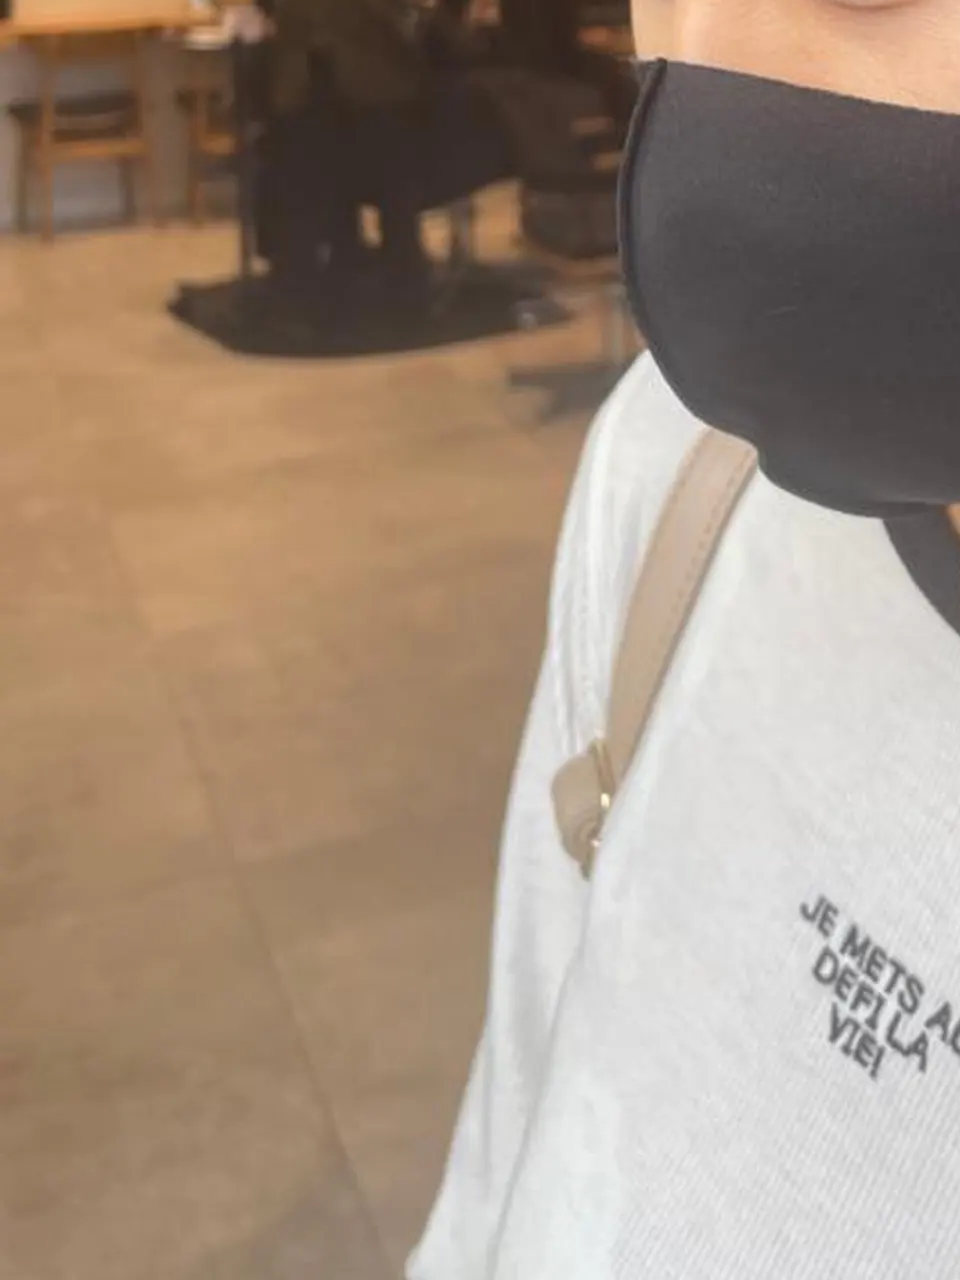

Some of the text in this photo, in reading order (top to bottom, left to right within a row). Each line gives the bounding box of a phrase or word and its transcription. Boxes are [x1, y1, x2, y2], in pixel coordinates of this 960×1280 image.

[799, 894, 839, 938] JE
[839, 923, 925, 1016] METS
[812, 945, 929, 1074] DEFI LA
